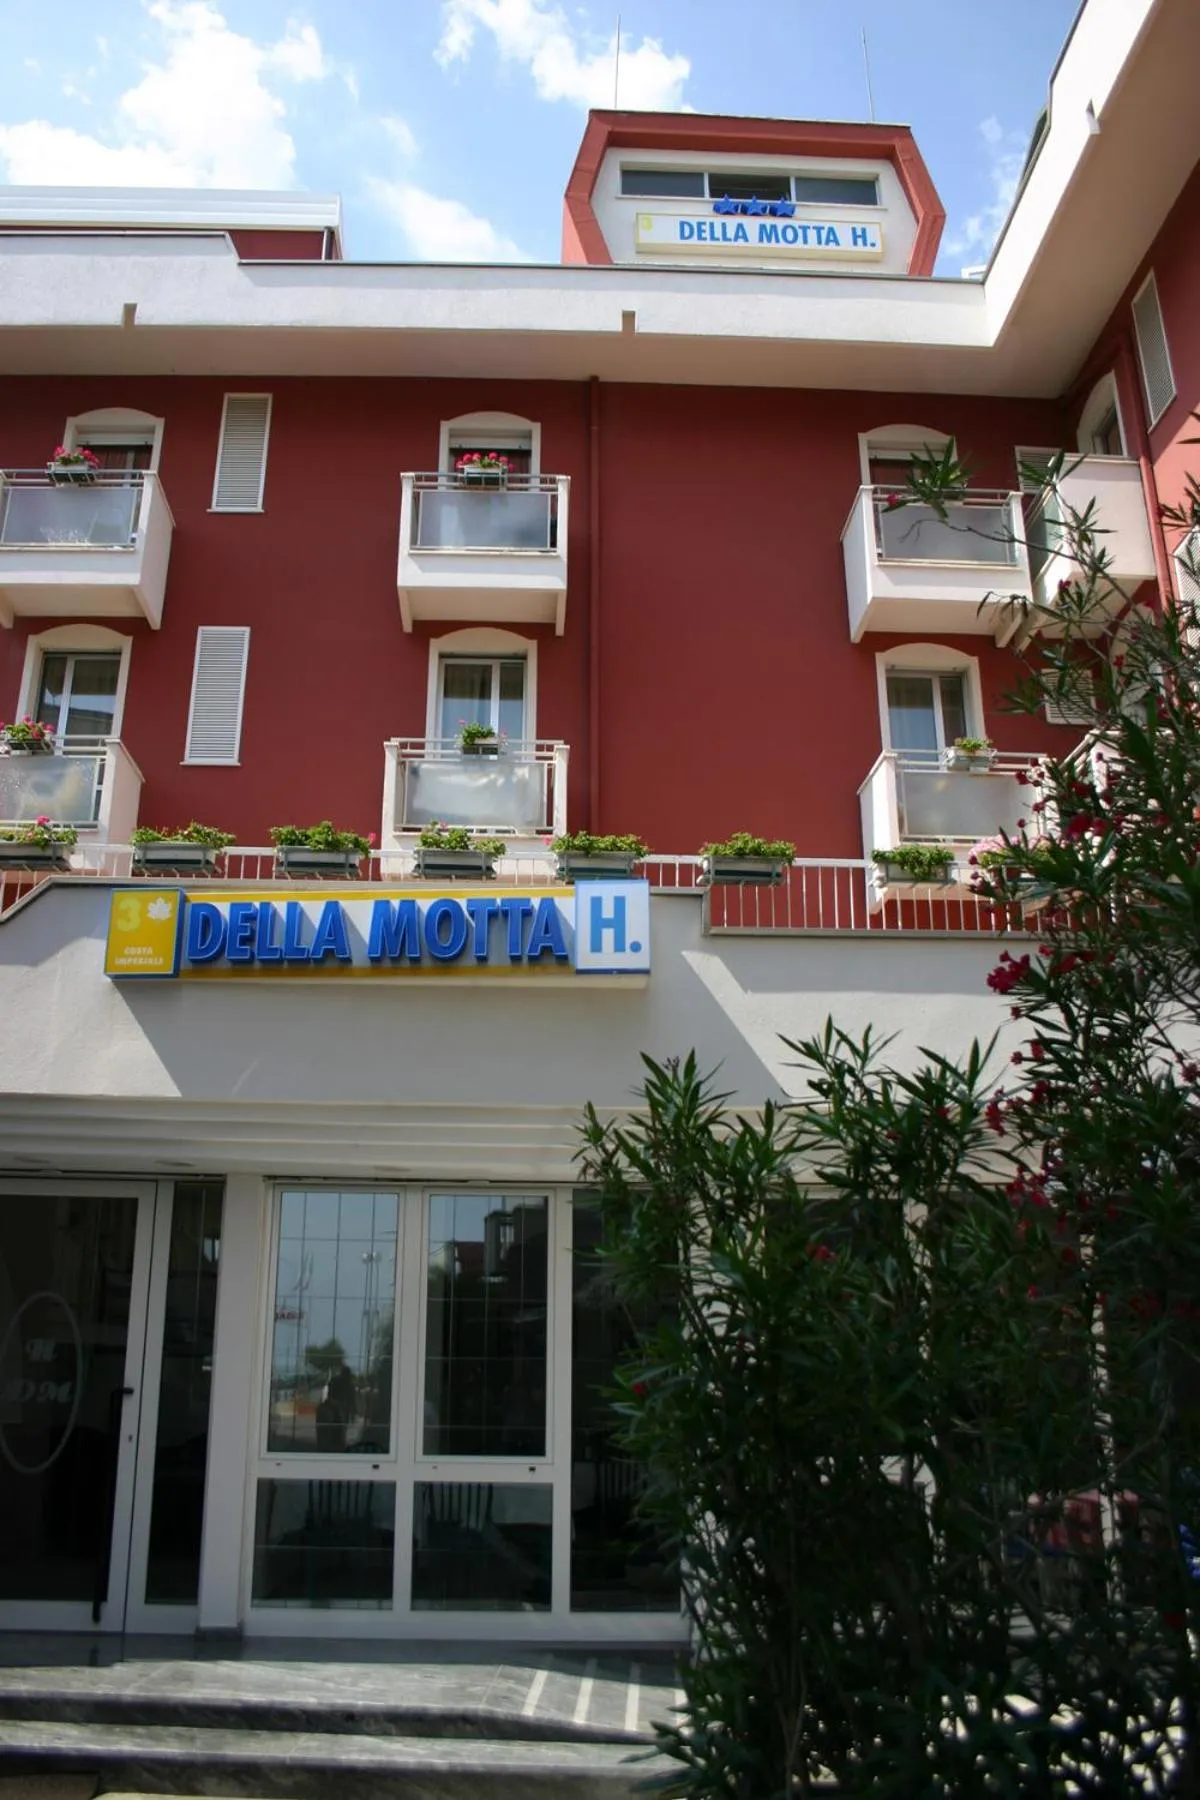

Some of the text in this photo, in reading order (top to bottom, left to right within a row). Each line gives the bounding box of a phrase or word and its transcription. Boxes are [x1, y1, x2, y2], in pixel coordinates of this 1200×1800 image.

[679, 220, 749, 244] DELLA
[757, 223, 840, 247] MOTTA
[851, 226, 877, 248] H.
[116, 897, 141, 932] 3
[188, 896, 642, 963] DELLA MOTTA H.
[123, 946, 153, 955] COSTA
